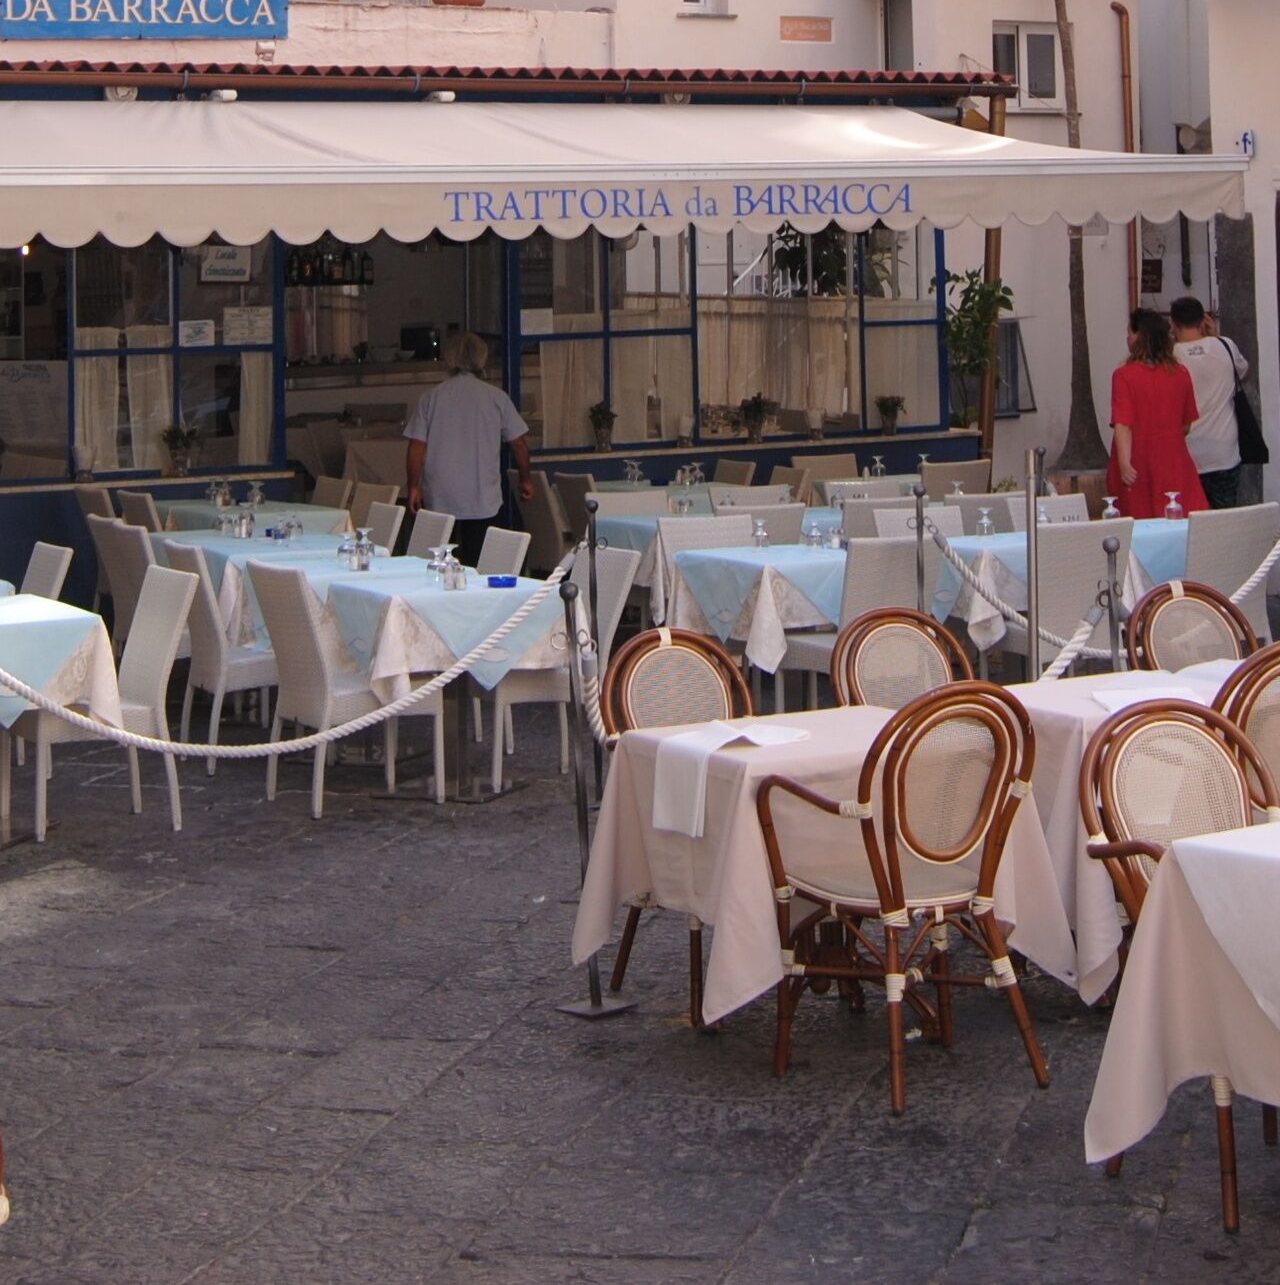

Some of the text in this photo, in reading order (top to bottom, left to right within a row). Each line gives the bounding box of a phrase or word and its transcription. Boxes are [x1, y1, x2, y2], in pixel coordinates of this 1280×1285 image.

[444, 183, 914, 223] TRATTORIA da BARRACCA
